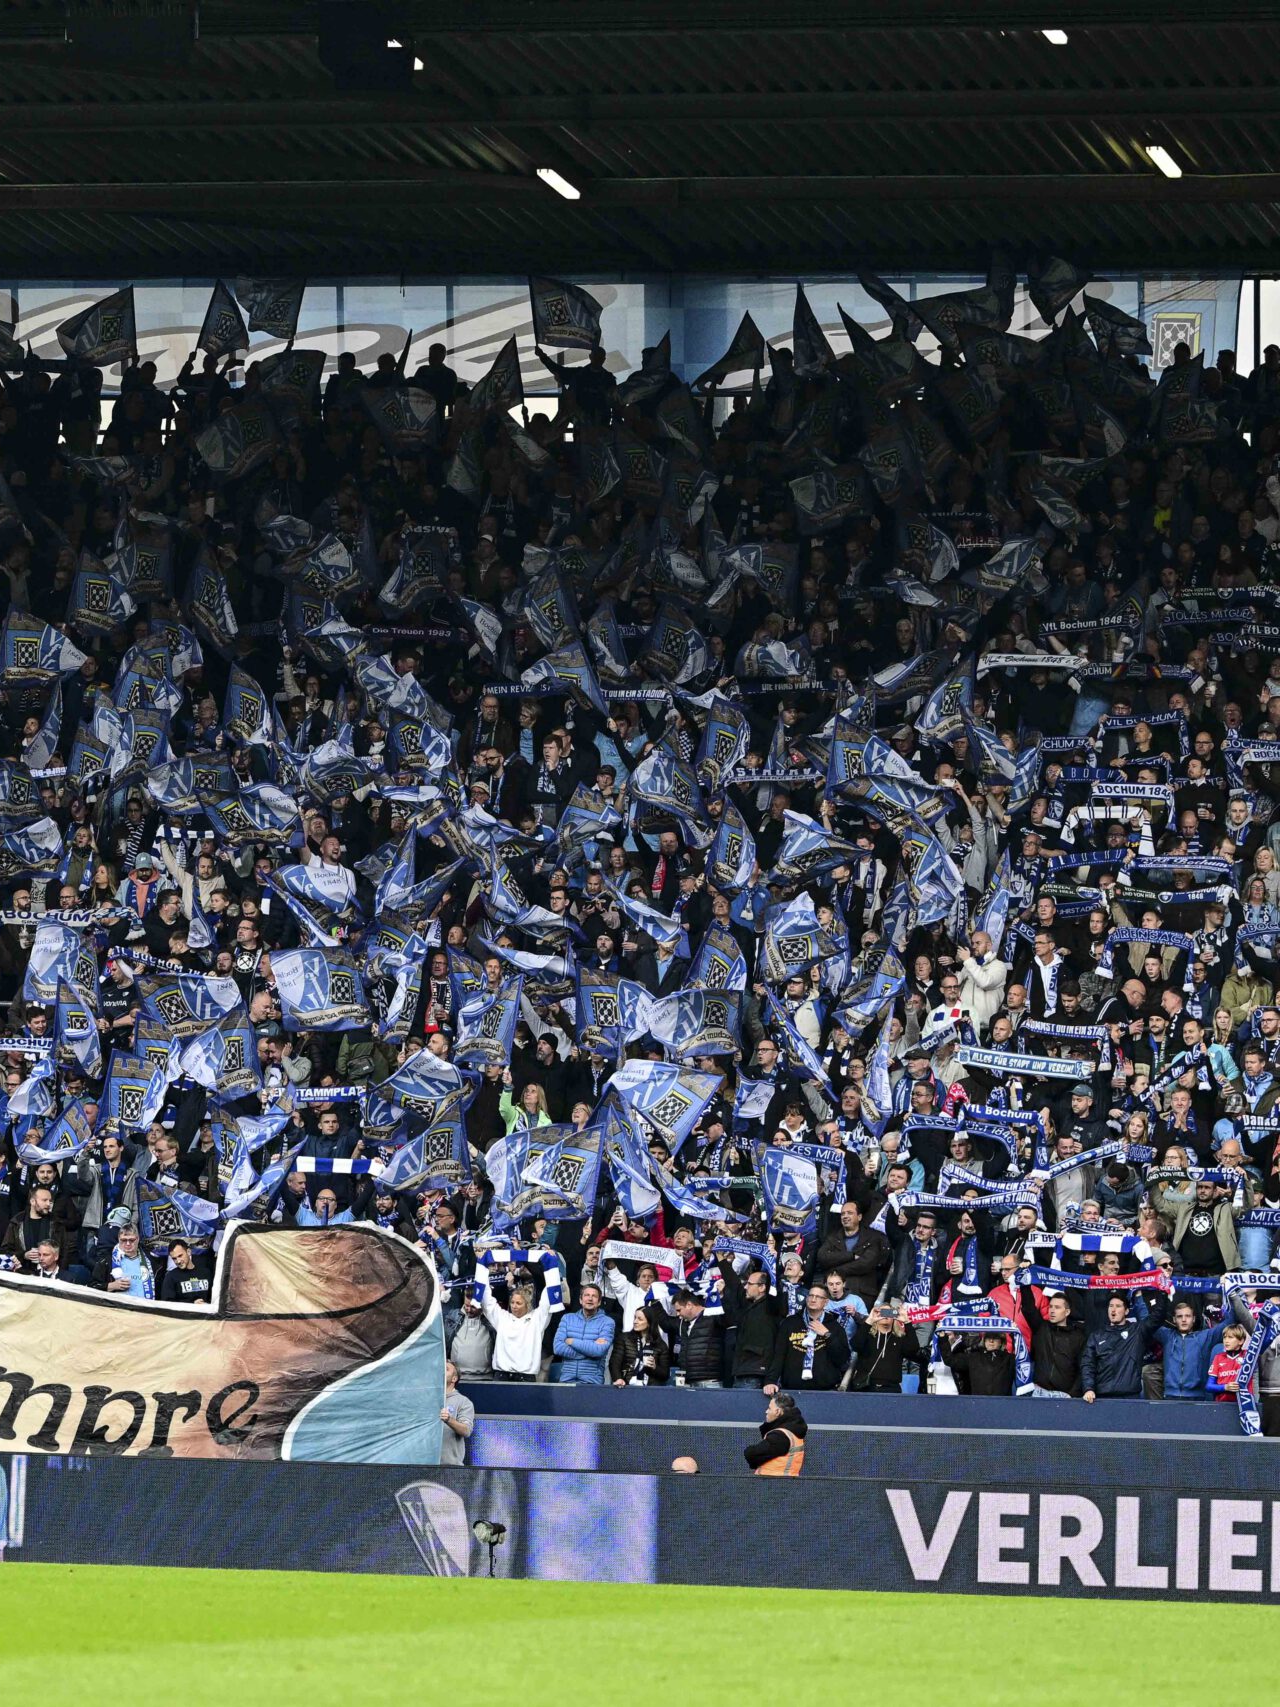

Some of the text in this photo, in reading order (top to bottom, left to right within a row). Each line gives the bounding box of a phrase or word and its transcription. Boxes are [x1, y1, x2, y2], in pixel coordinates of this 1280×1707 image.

[1042, 615, 1122, 632] VfL Bochum 1848
[372, 626, 452, 638] Die Treuen 1983
[486, 685, 508, 695] MEIN
[1106, 716, 1123, 727] VfL
[1097, 784, 1147, 796] BOCHUM
[322, 878, 342, 887] 1848
[4, 909, 91, 923] BOCHUM
[215, 982, 234, 993] 1848
[1055, 1023, 1087, 1035] DU IN EIN
[923, 1026, 954, 1052] BOCHUM
[971, 1052, 993, 1063] ALLES
[993, 1054, 1008, 1067] FÜR
[1008, 1057, 1031, 1069] STADT
[1031, 1060, 1045, 1072] UND
[296, 1086, 368, 1098] STAMMPLAT
[964, 1102, 1033, 1120] VfL Bochum
[1242, 1114, 1279, 1127] Danke
[917, 1193, 935, 1204] UND
[970, 1196, 981, 1205] DU
[991, 1195, 1005, 1204] EIN
[1005, 1192, 1039, 1205] STADION
[610, 1242, 669, 1260] BOCHUM
[1037, 1272, 1047, 1281] VfL
[1047, 1273, 1074, 1285] BOCHUM
[1073, 1276, 1088, 1285] 1848
[1095, 1278, 1102, 1286] FC
[1102, 1277, 1127, 1286] BAYERN
[1127, 1274, 1156, 1286] MÜNCHEN
[1227, 1274, 1247, 1285] VfL
[971, 1303, 989, 1313] 1848
[957, 1317, 1012, 1328] BOCHUM
[1238, 1322, 1265, 1385] BOCHUM
[1240, 1388, 1254, 1406] VfL
